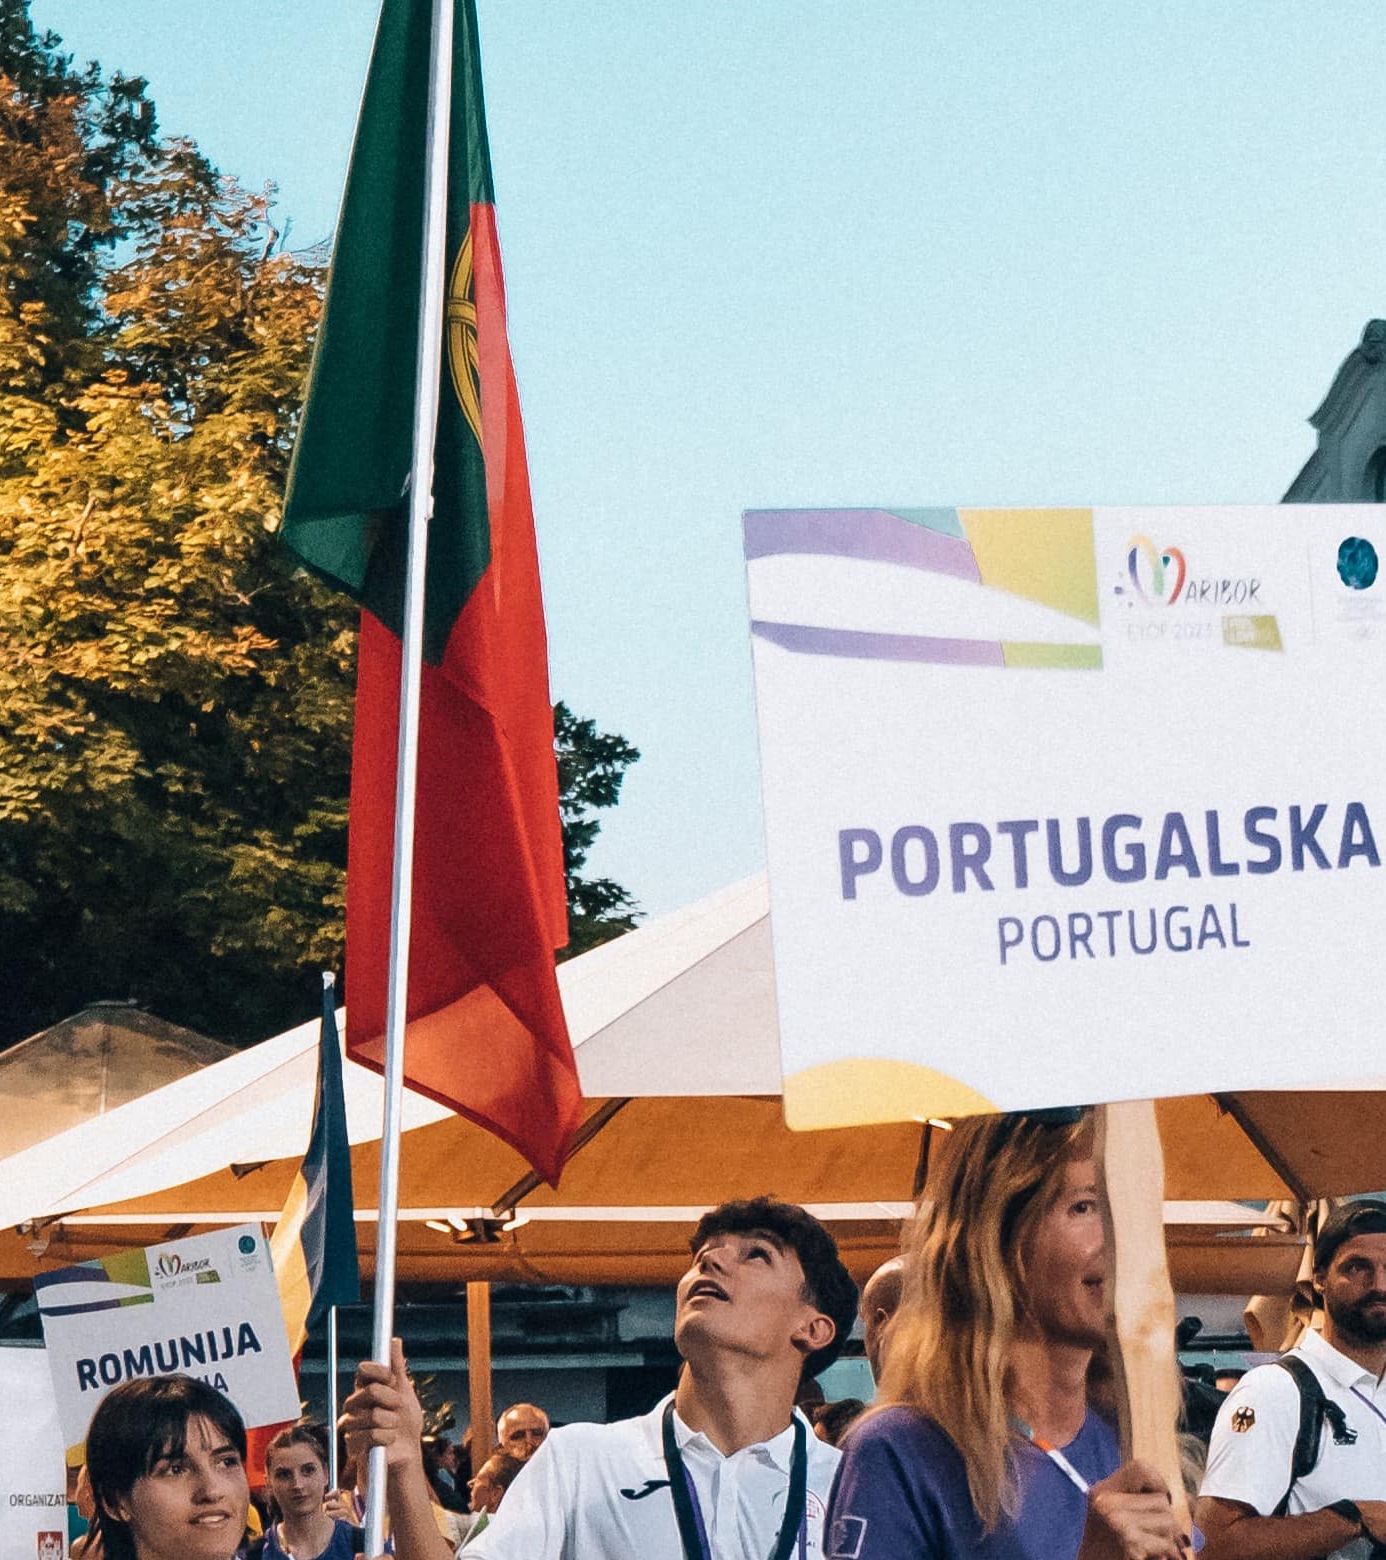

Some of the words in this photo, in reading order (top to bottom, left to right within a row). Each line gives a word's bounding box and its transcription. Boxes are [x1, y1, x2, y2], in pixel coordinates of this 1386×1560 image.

[837, 800, 1382, 901] PORTUGALSKA
[997, 902, 1251, 966] PORTUGAL
[76, 1322, 262, 1392] ROMUNIJA
